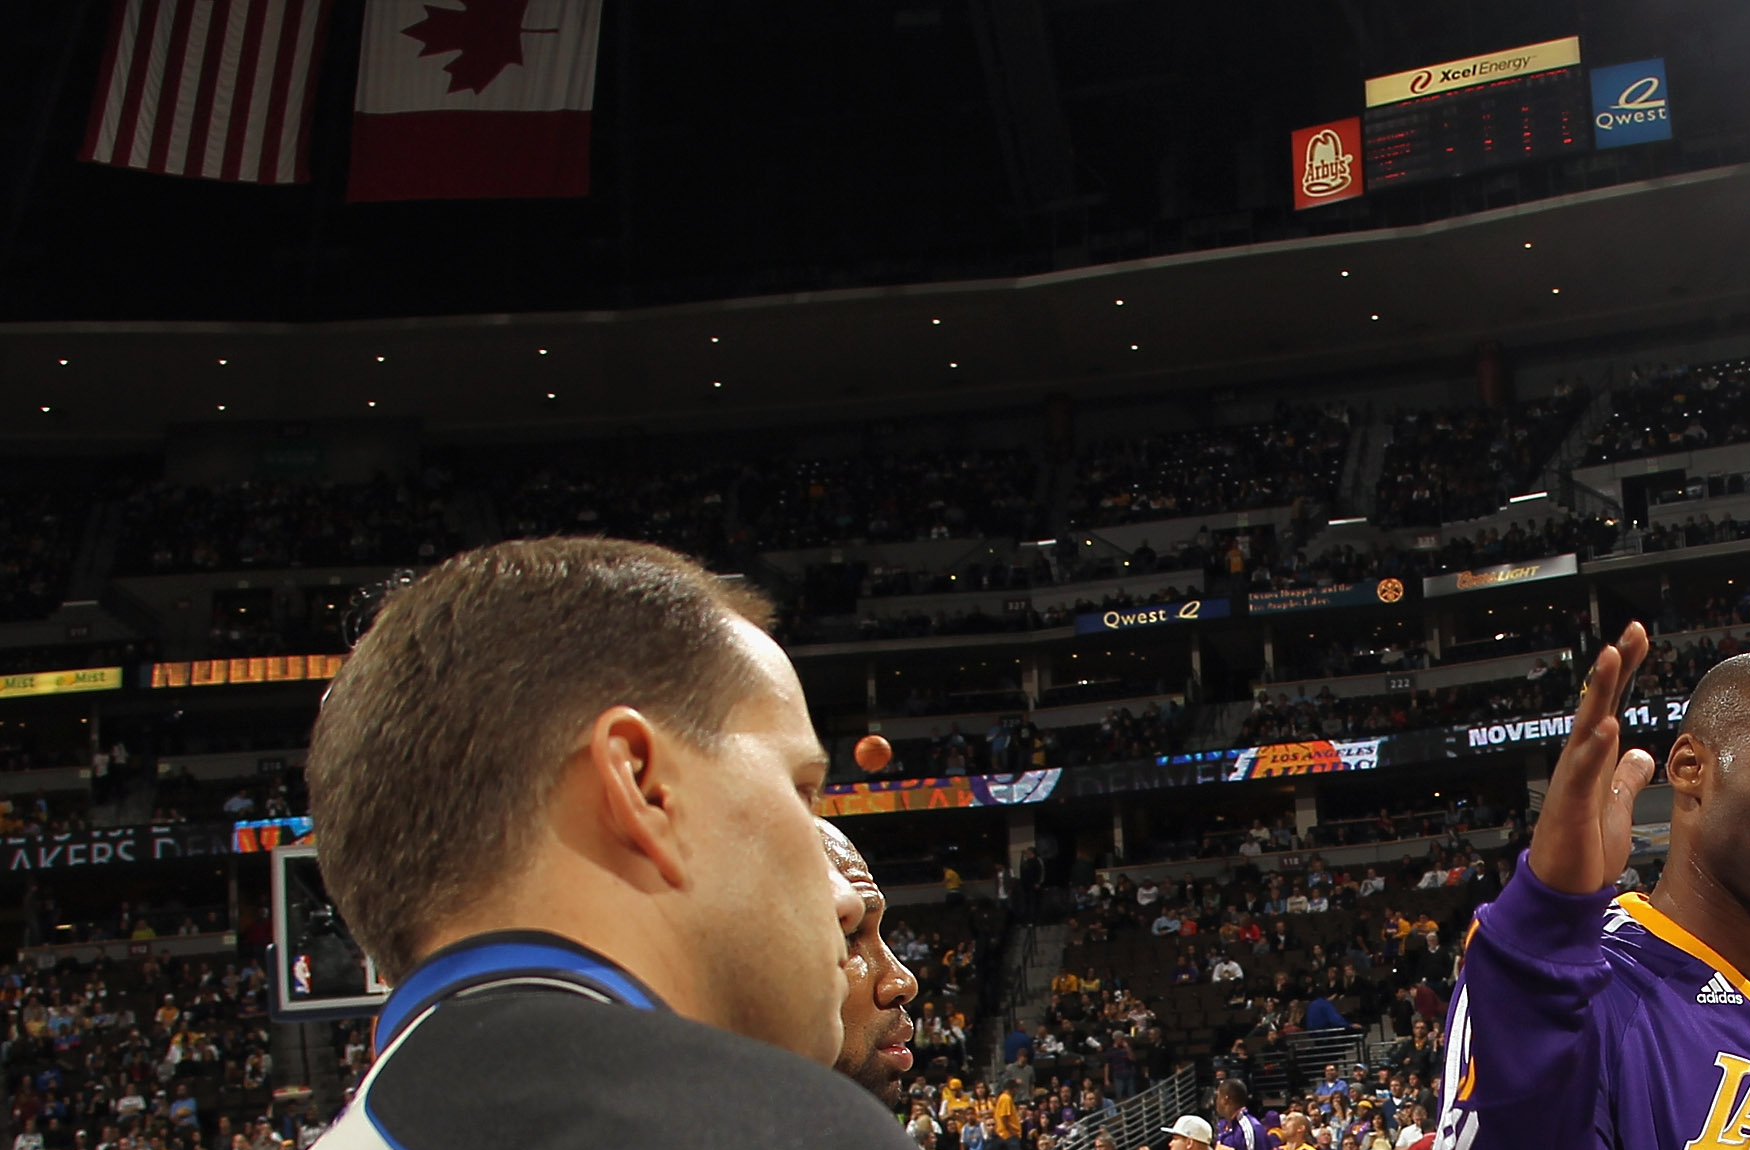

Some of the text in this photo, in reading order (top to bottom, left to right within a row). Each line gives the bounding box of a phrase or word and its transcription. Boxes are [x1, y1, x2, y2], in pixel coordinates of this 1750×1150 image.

[1440, 55, 1532, 83] Xcel Energy
[1596, 107, 1668, 130] Qwest
[1305, 160, 1347, 183] Arby's
[1497, 565, 1541, 581] LIGHT
[1103, 608, 1169, 630] Qwest
[1389, 677, 1411, 689] 222
[1624, 704, 1659, 727] 11,
[1271, 745, 1375, 764] LOS ANGELES
[1696, 990, 1744, 1006] adidas
